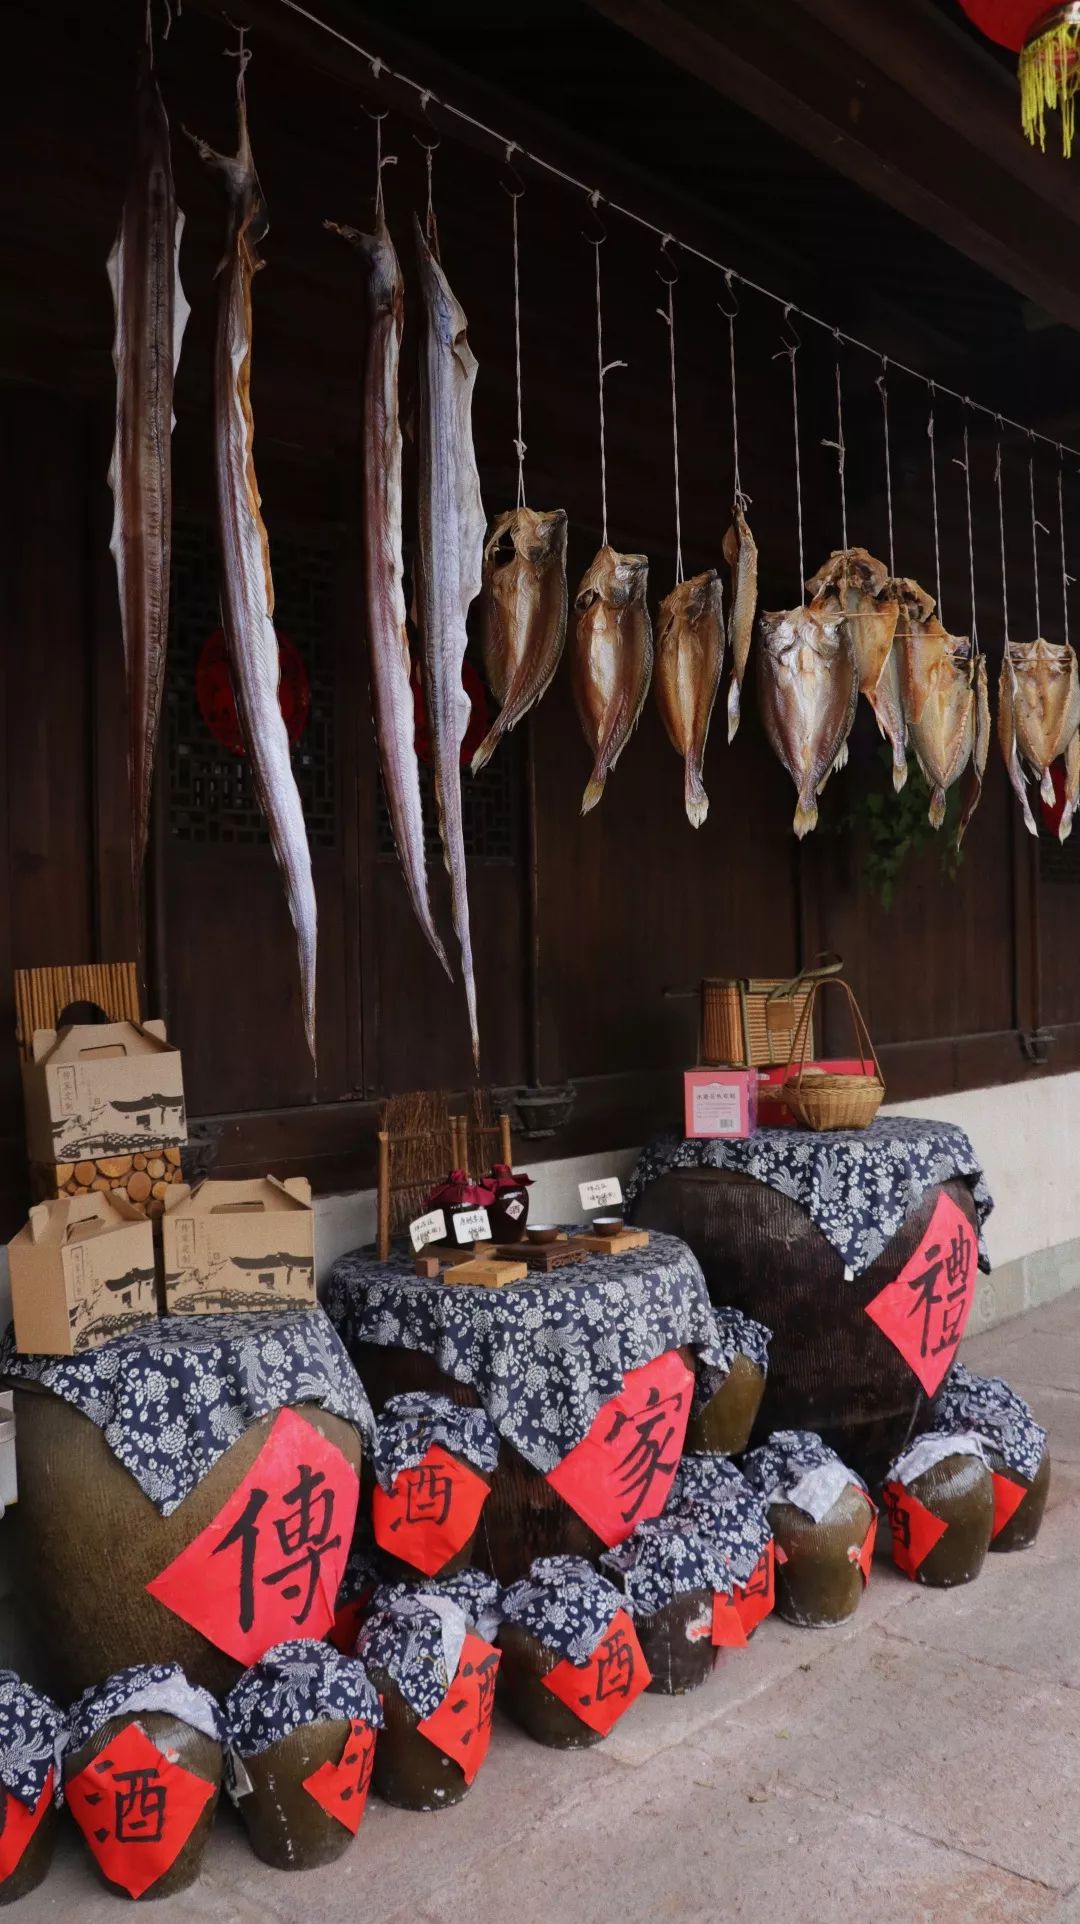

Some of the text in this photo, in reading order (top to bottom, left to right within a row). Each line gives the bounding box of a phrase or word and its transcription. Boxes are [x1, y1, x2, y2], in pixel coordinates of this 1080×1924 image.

[908, 1224, 972, 1358] 禮
[387, 1466, 453, 1531] 酒
[605, 1387, 682, 1523] 家
[212, 1465, 342, 1632] 傳
[452, 1650, 499, 1745] 酒
[573, 1629, 633, 1706] 酒
[83, 1760, 166, 1843] 酒
